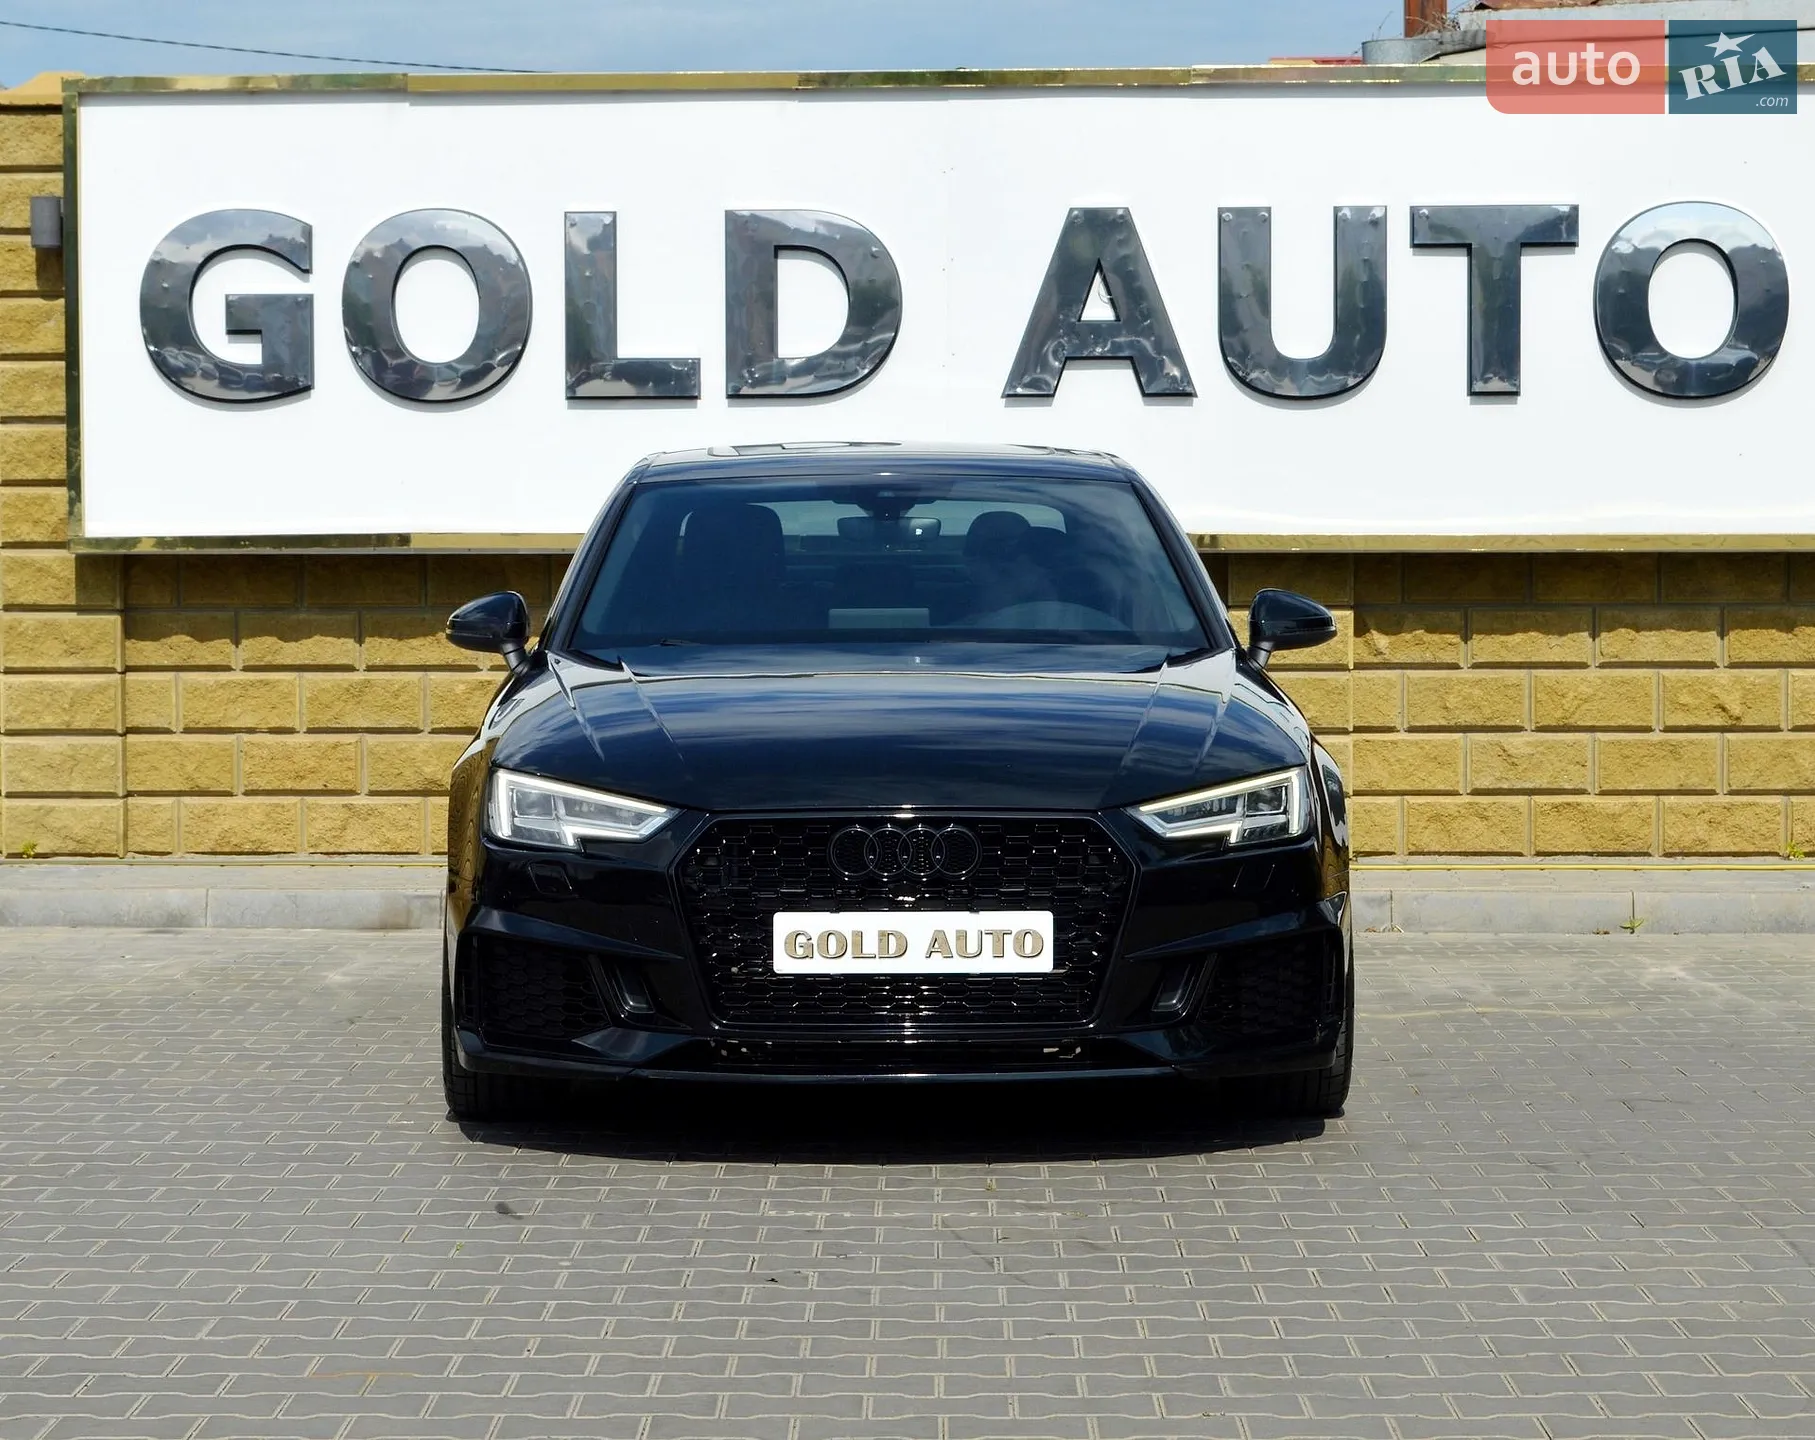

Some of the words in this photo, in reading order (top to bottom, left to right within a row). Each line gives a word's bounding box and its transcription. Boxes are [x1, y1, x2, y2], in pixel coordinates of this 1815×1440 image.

[139, 208, 903, 405] GOLD
[1001, 201, 1790, 400] AUTO
[783, 929, 909, 959] GOLD
[925, 928, 1045, 958] AUTO
